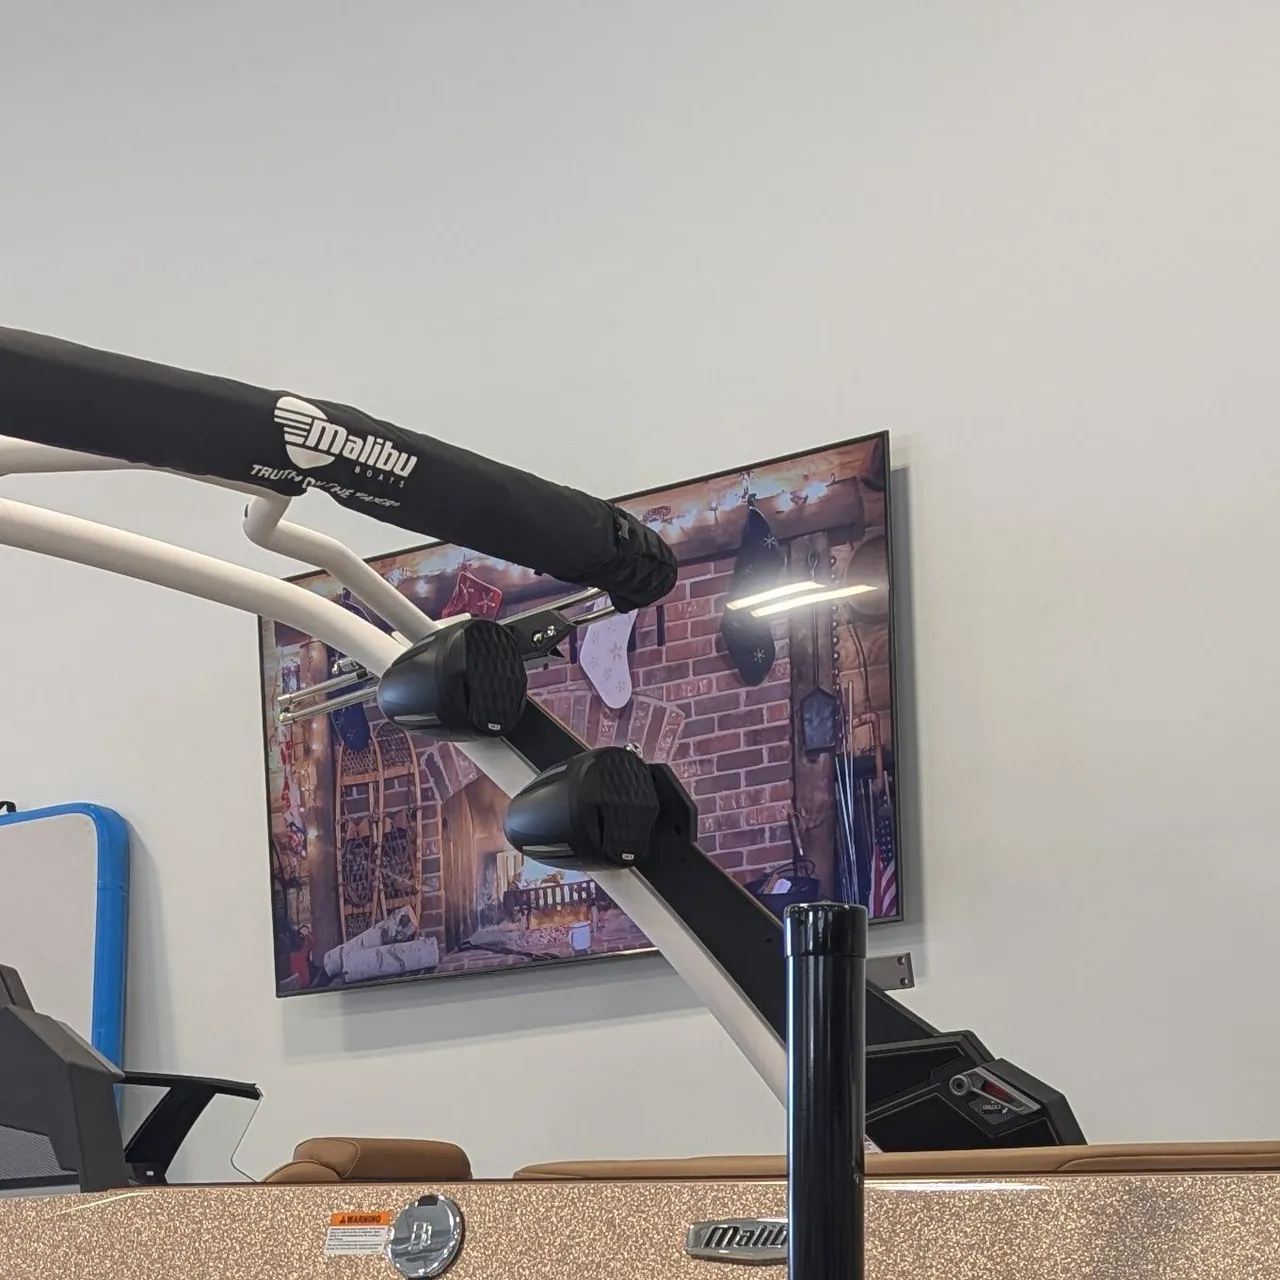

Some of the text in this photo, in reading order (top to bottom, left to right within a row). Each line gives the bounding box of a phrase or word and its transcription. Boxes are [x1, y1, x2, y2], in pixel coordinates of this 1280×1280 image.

[304, 418, 418, 478] Malibu
[354, 464, 405, 488] BOATS
[701, 1225, 788, 1249] Malib
